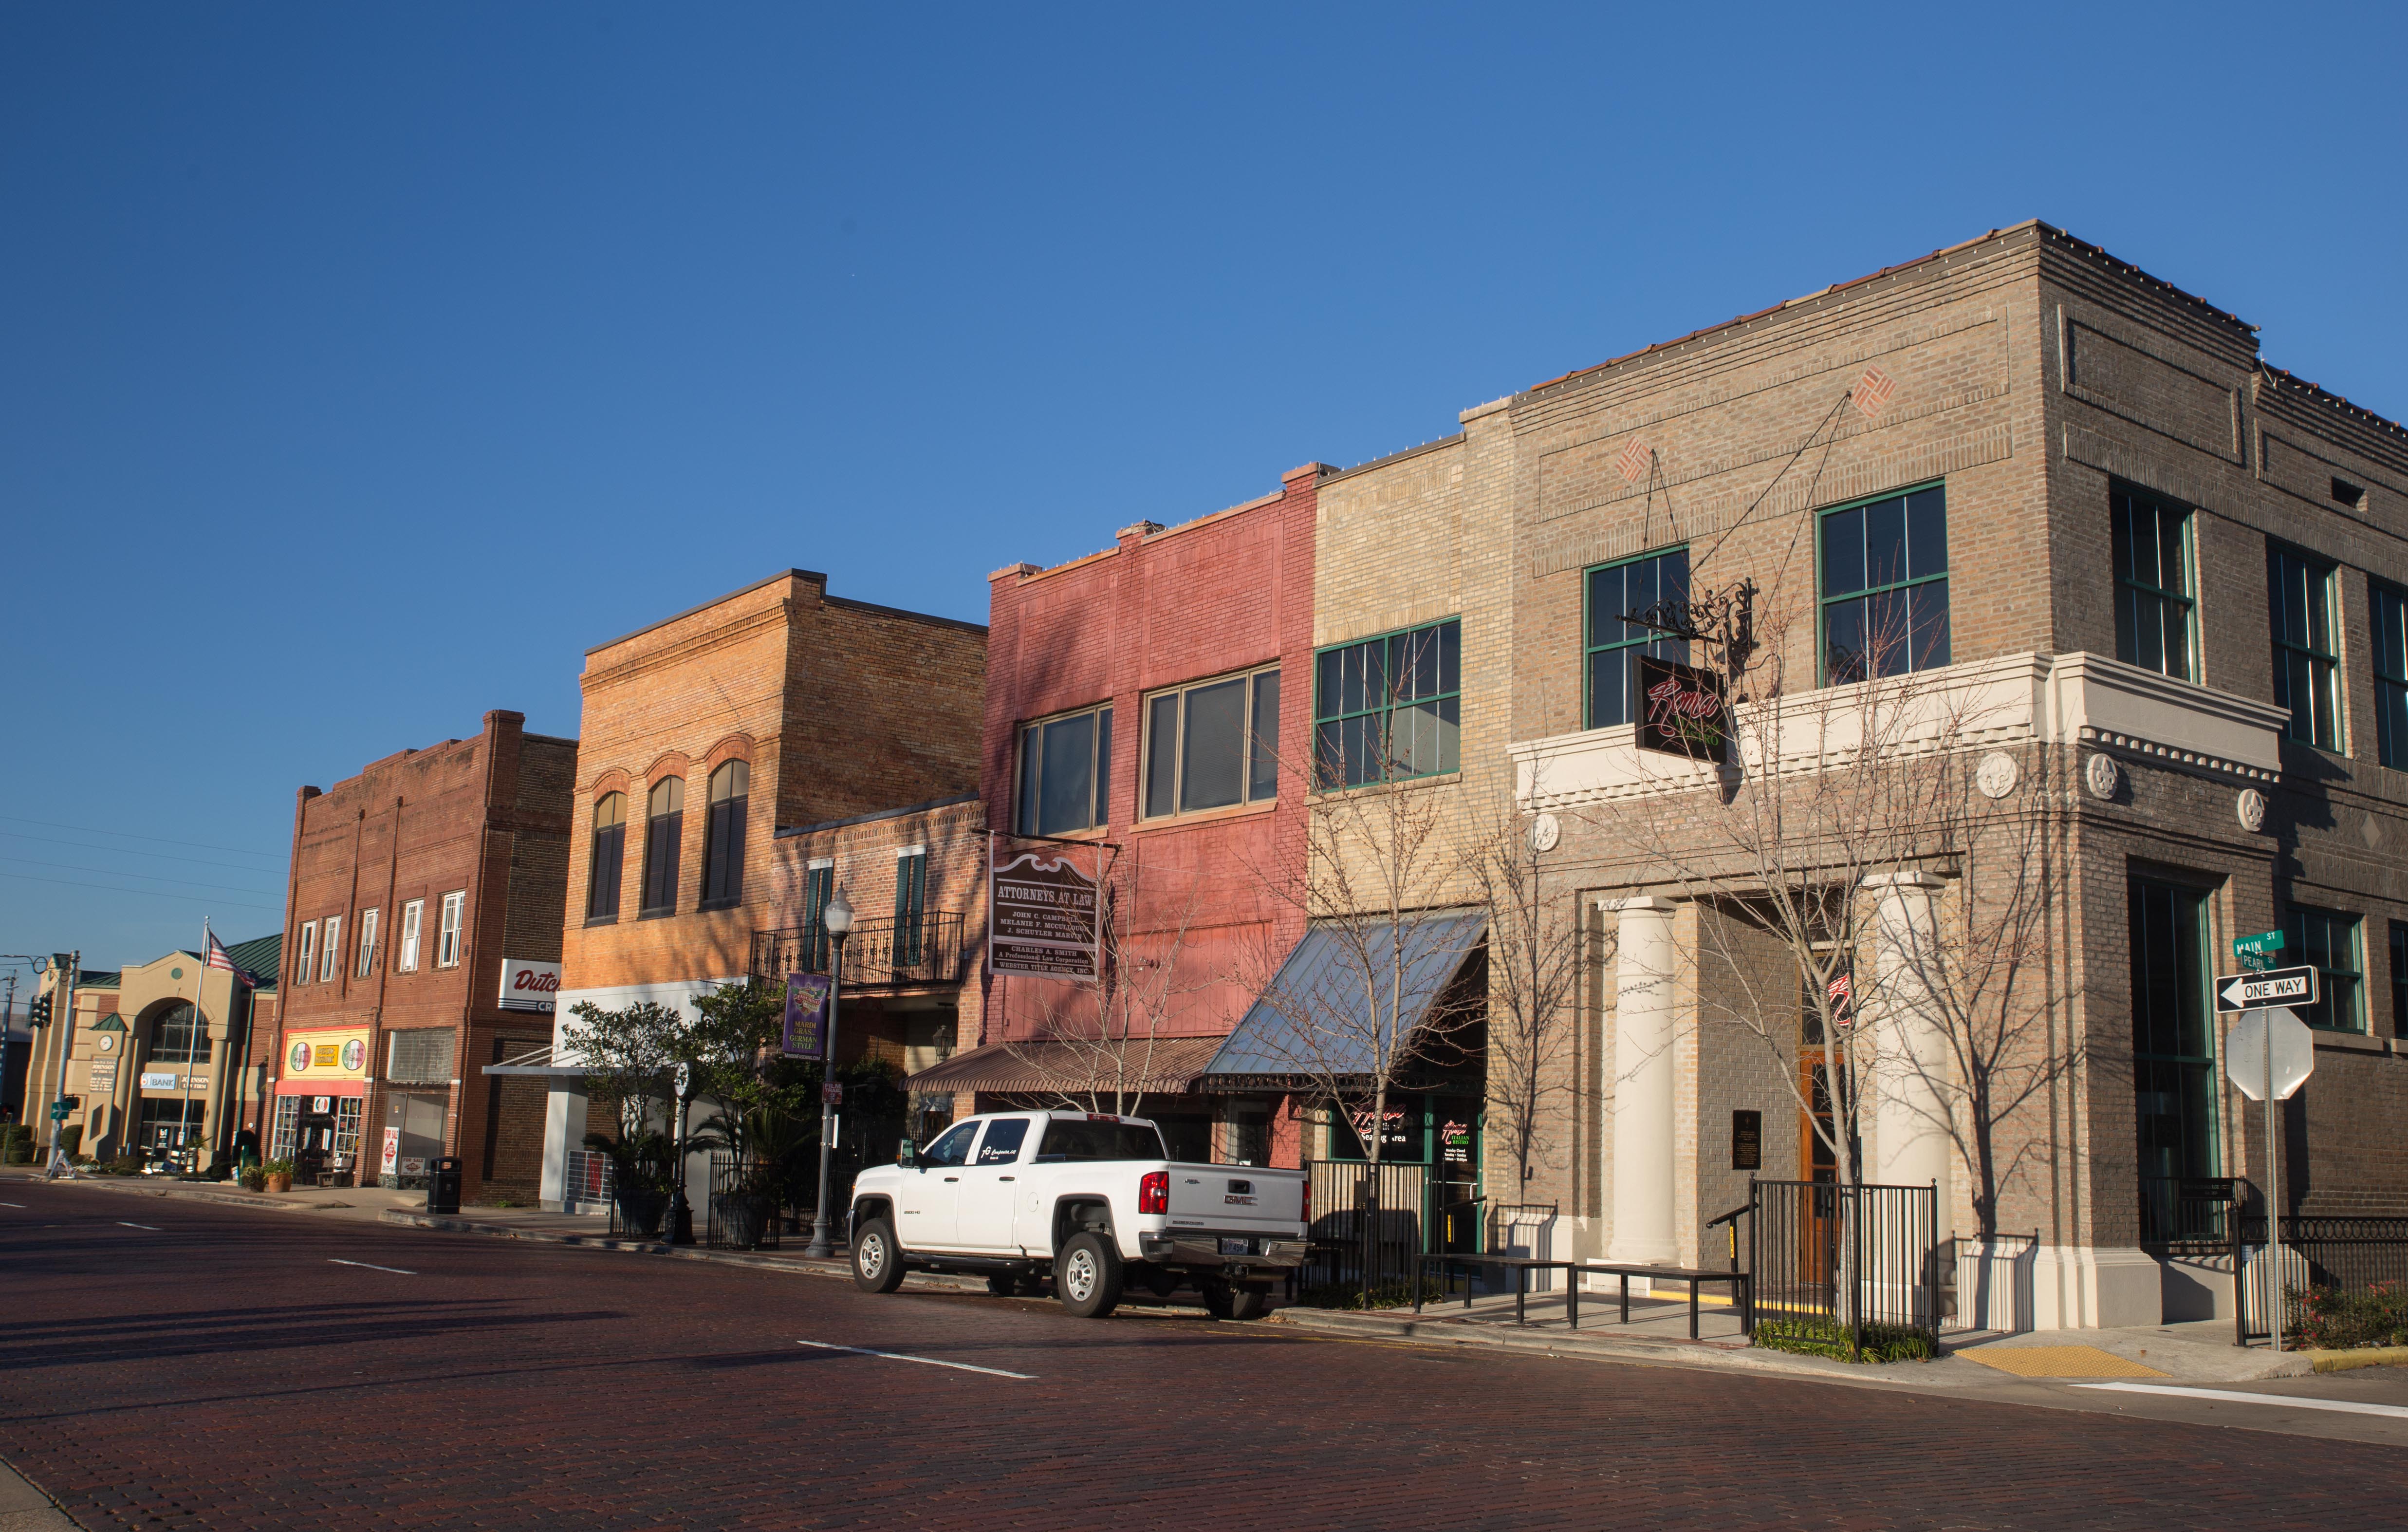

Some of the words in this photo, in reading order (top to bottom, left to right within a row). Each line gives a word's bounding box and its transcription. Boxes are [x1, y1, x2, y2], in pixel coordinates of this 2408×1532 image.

[1648, 676, 1718, 737] Roma
[998, 885, 1055, 902] ATTORNEYS
[1058, 892, 1070, 904] AT
[1073, 893, 1092, 906] LAW
[1000, 918, 1034, 927] MELANIE
[1042, 914, 1079, 922] CAMPBELL
[1016, 928, 1052, 936] SCHUYLER
[2237, 940, 2261, 954] MAIN
[2243, 955, 2264, 969] PEARL
[2245, 983, 2270, 998] ONE
[2275, 979, 2301, 994] WAY
[797, 994, 820, 1005] FASCHING
[1224, 1195, 1253, 1204] GMC
